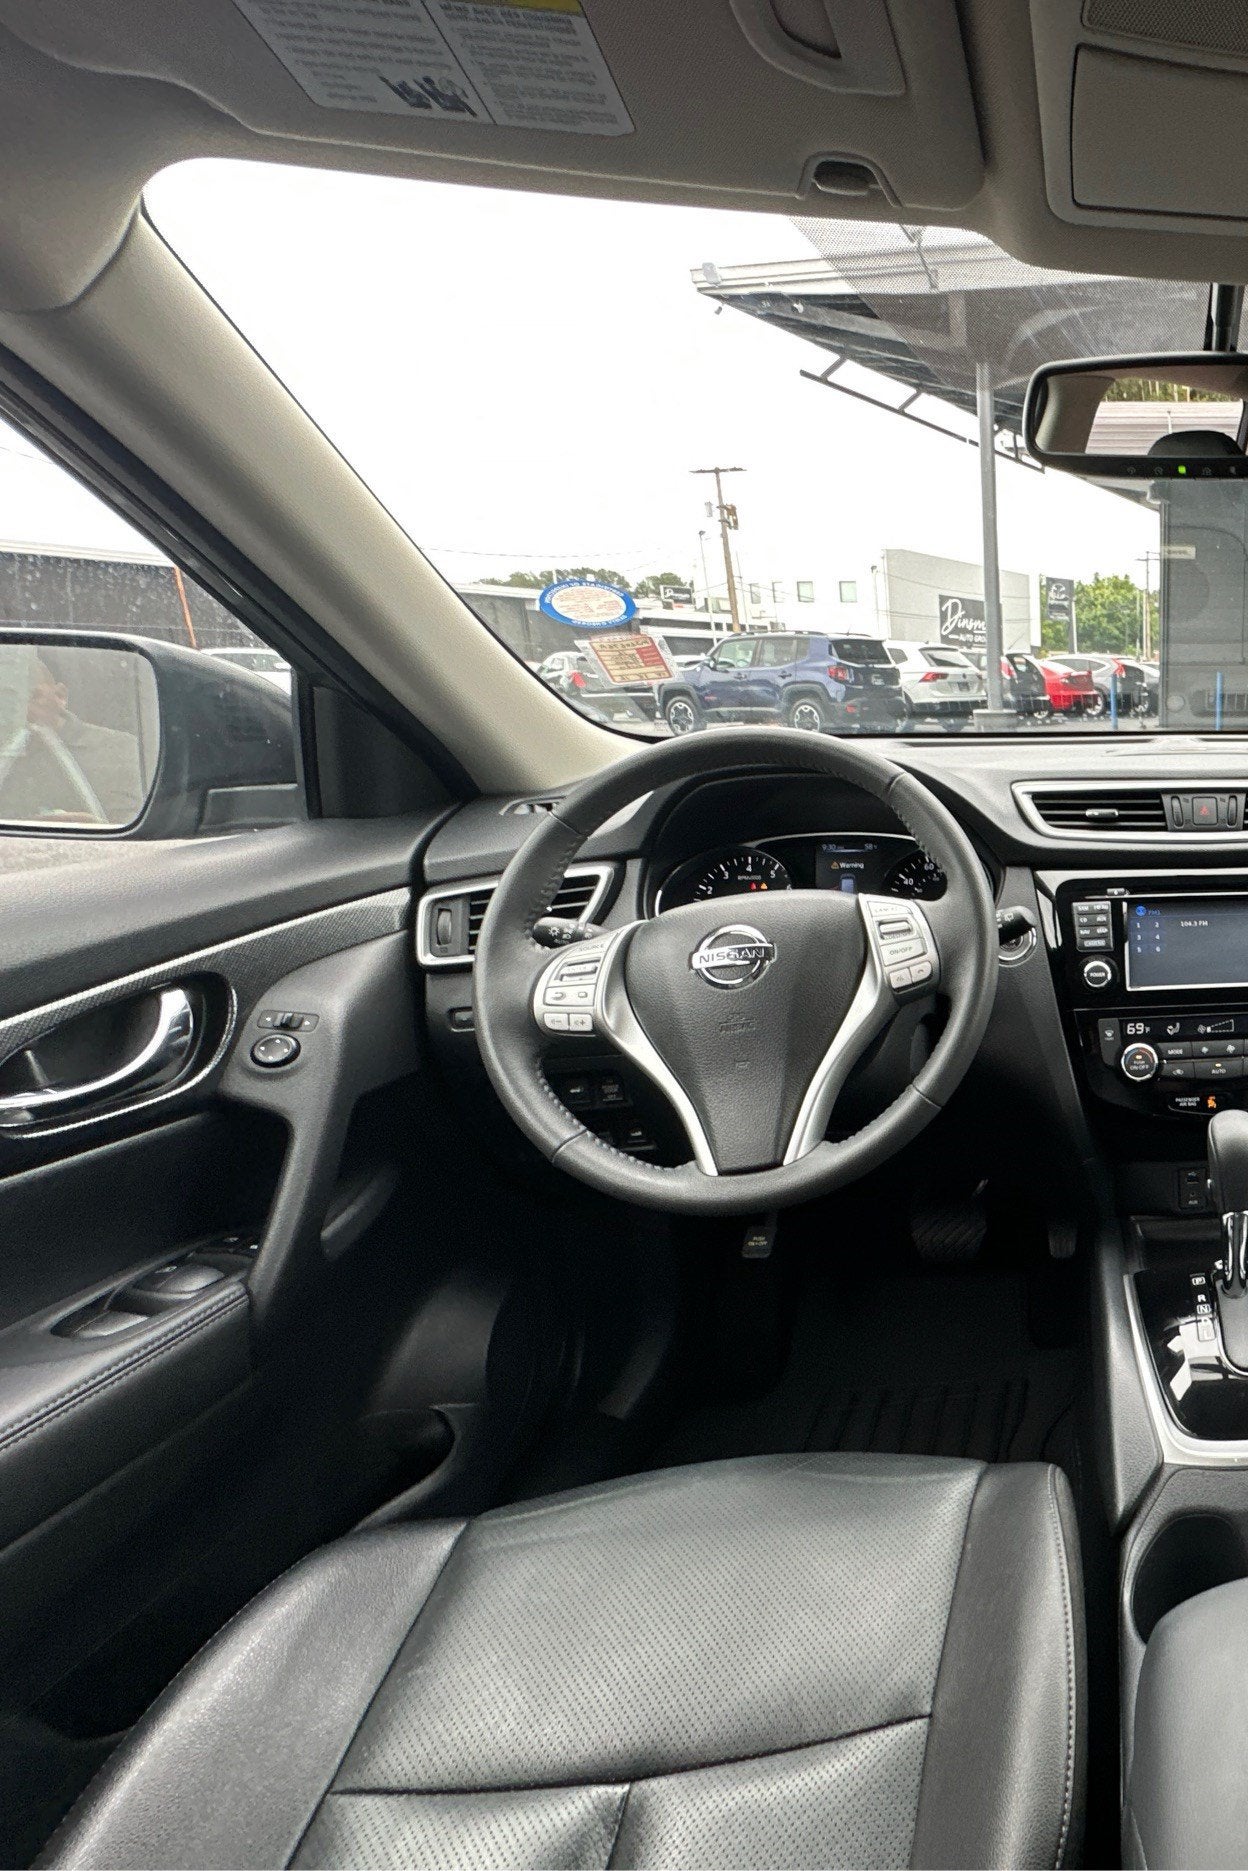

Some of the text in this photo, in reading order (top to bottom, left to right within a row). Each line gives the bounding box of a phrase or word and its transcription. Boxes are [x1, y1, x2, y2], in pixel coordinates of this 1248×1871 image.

[941, 599, 986, 635] Dinsm
[746, 864, 752, 872] 4
[840, 862, 864, 871] Warning
[924, 863, 935, 871] 60
[723, 872, 729, 880] 3
[770, 870, 776, 878] 5
[904, 877, 914, 886] 40
[707, 886, 713, 894] 2
[699, 948, 765, 964] NISSAN
[1198, 1294, 1206, 1303] R
